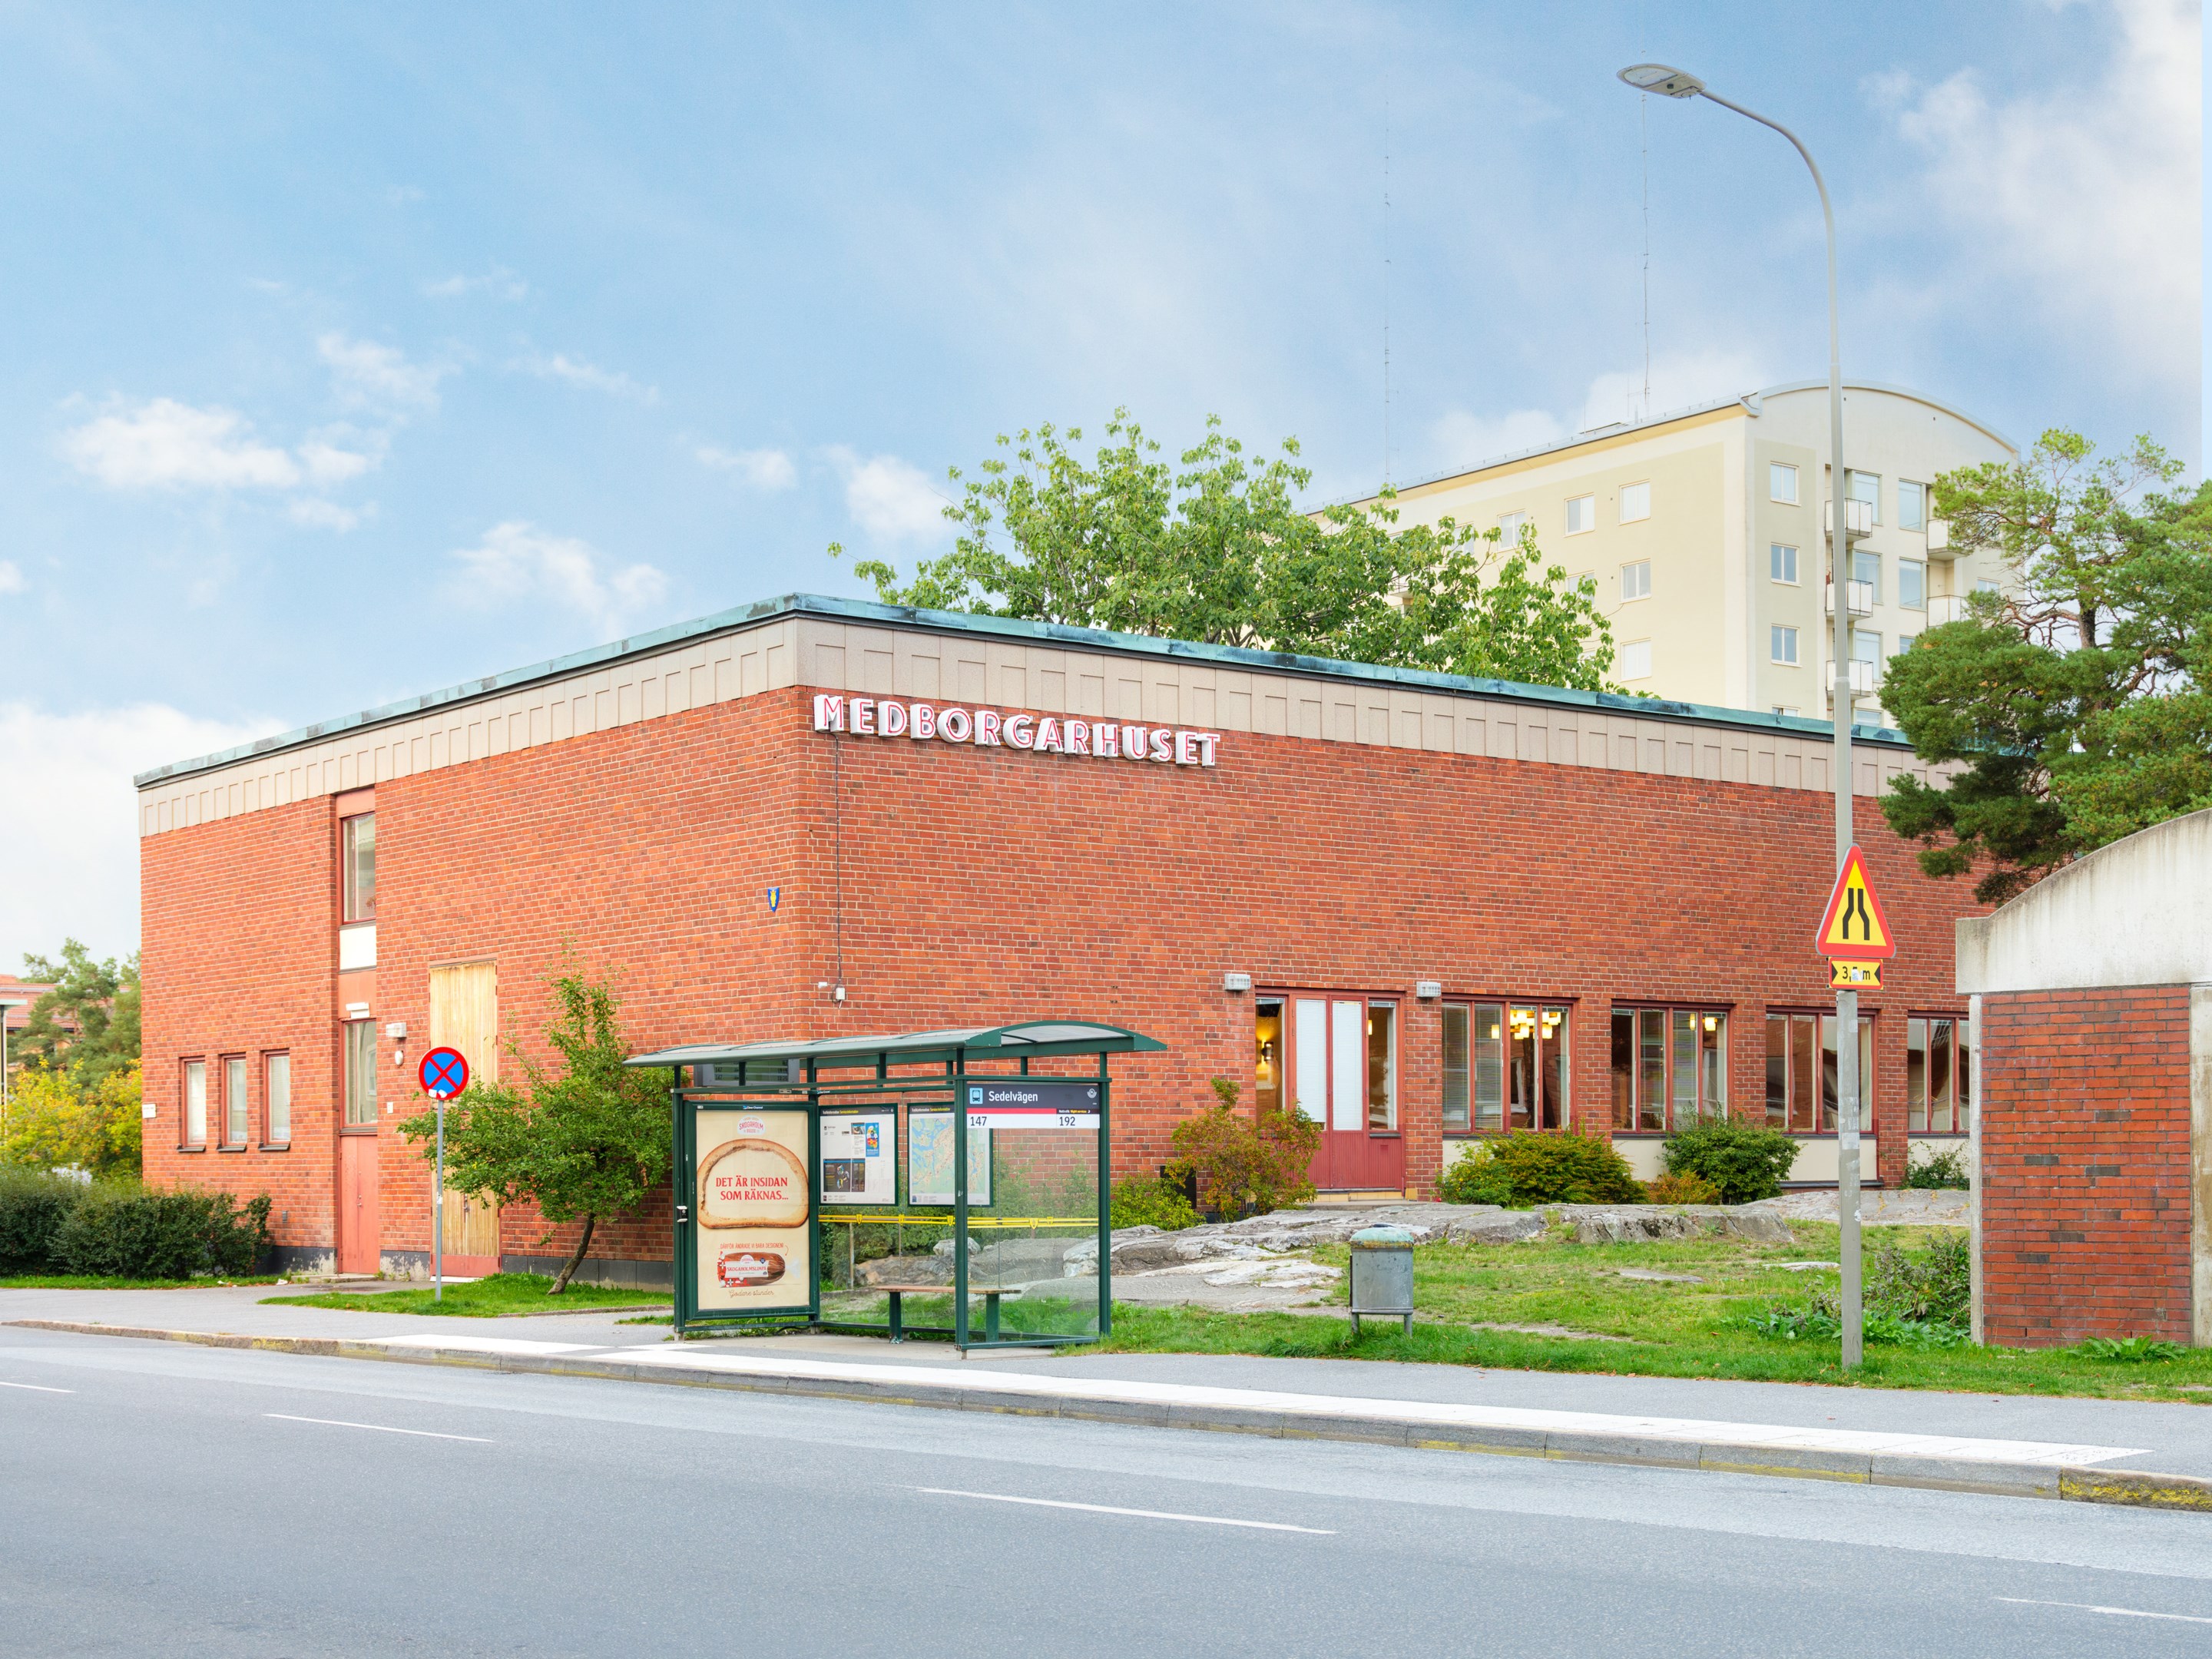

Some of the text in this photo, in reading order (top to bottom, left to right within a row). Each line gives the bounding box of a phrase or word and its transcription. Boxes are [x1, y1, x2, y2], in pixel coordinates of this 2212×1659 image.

[813, 694, 1220, 767] MEDBORGARHUSET
[988, 1091, 1038, 1103] Sedelvägen
[739, 1121, 764, 1131] SKOGAHOLM
[970, 1116, 987, 1126] 147
[1059, 1116, 1075, 1126] 192
[716, 1175, 787, 1187] DET ÄR INSIDAN
[720, 1188, 789, 1200] SOM RÄKNAS...
[728, 1289, 752, 1299] Godare
